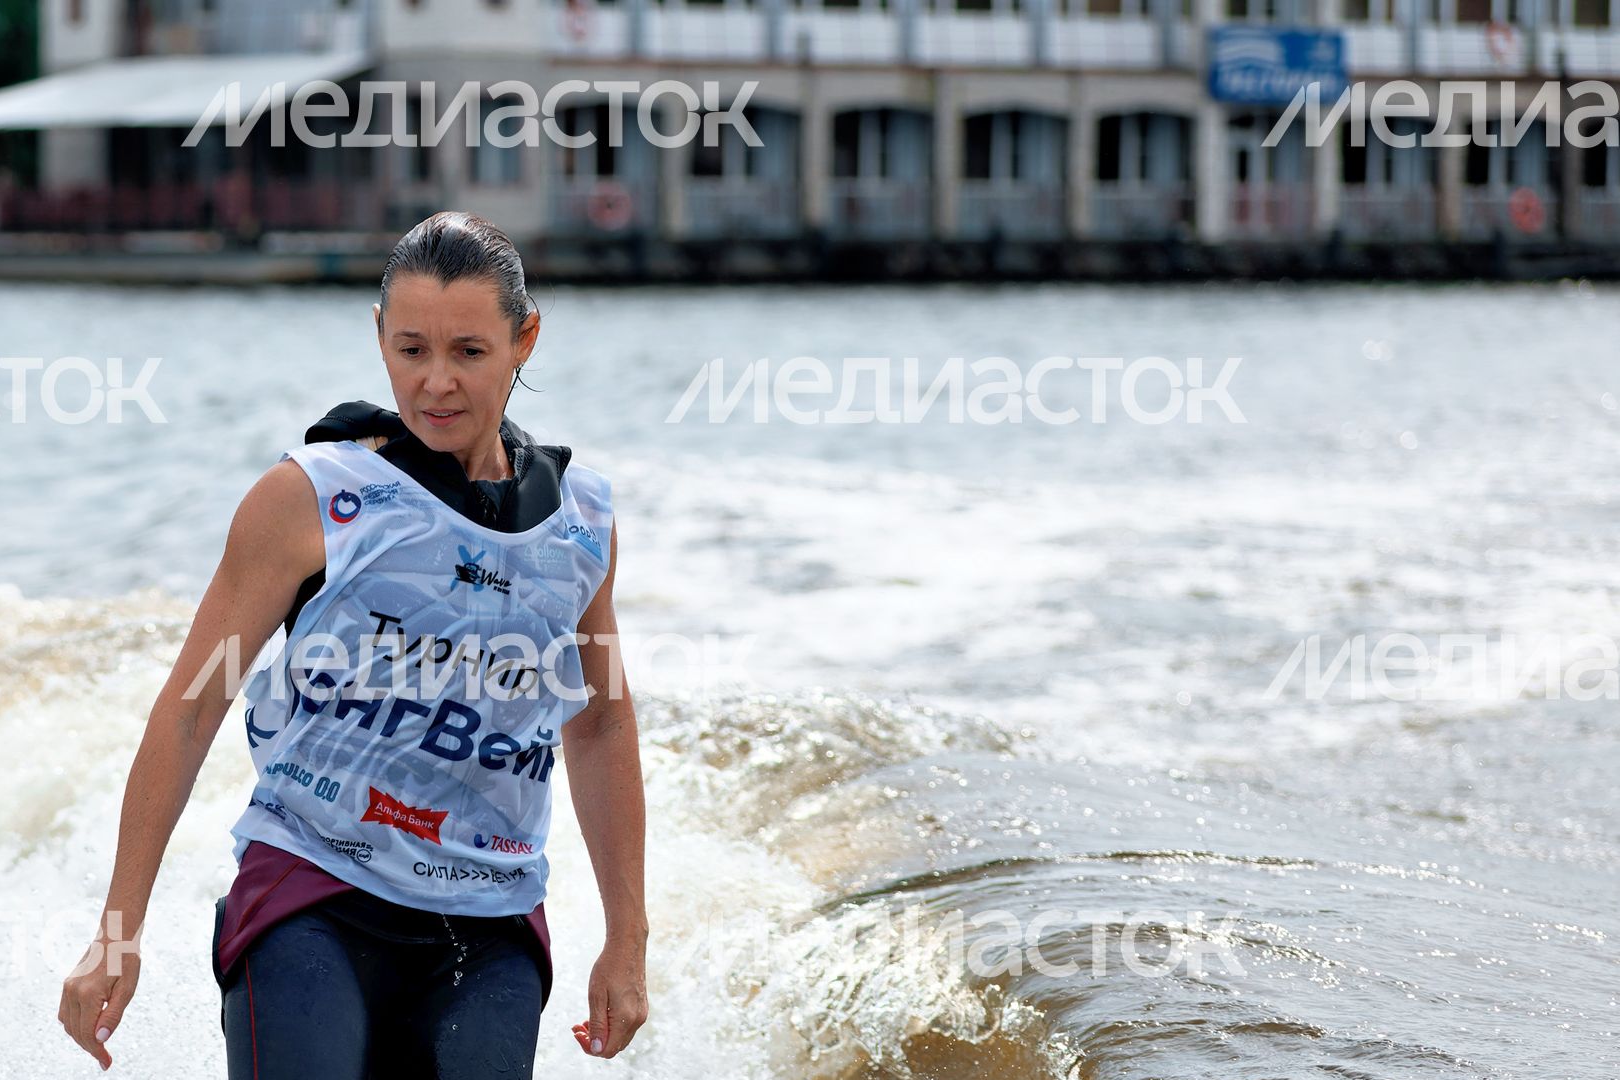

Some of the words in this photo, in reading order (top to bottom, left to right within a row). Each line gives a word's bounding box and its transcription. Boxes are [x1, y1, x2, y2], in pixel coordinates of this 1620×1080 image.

[369, 610, 539, 700] Турнир
[374, 801, 406, 821] Альфа
[408, 814, 435, 829] Банк
[491, 835, 533, 854] TASSAY
